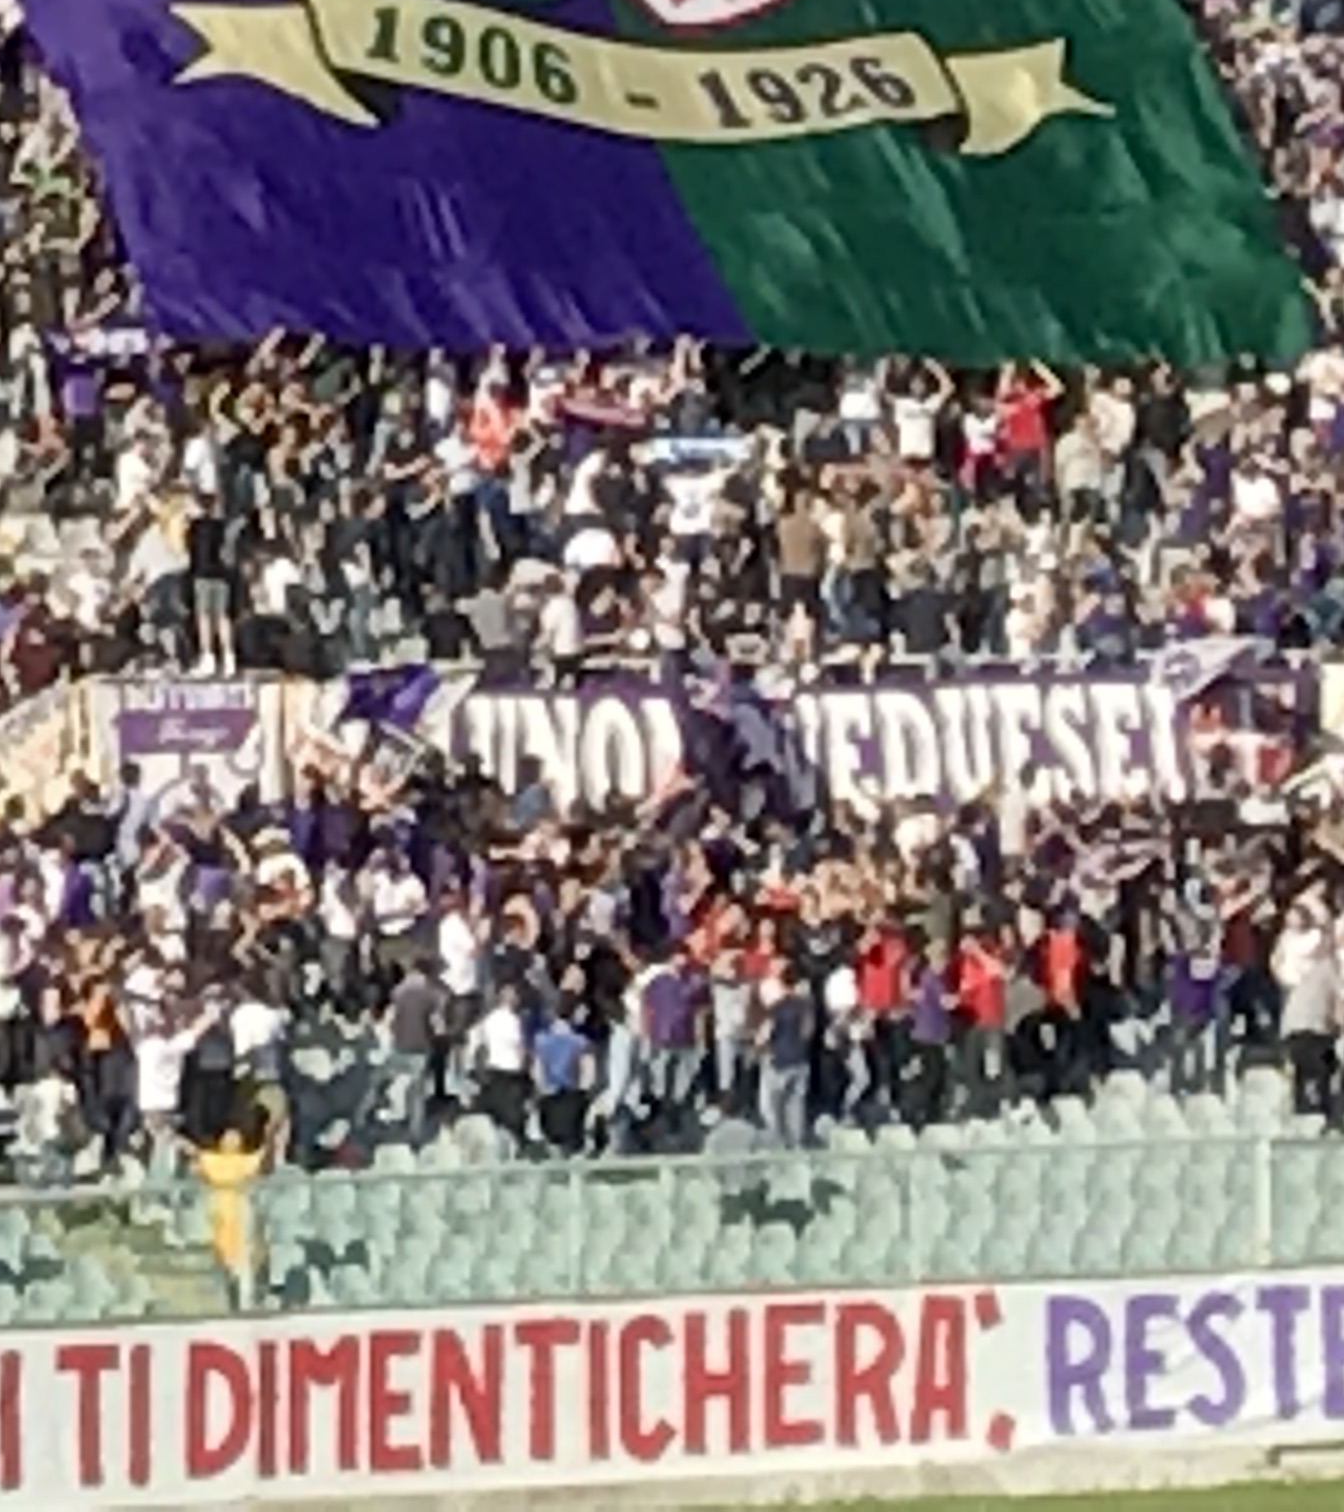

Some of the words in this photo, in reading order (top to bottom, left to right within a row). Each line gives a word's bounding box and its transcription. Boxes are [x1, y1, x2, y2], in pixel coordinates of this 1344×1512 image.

[365, 6, 578, 105] 1906
[698, 55, 918, 129] 1926
[56, 1344, 151, 1488] TI
